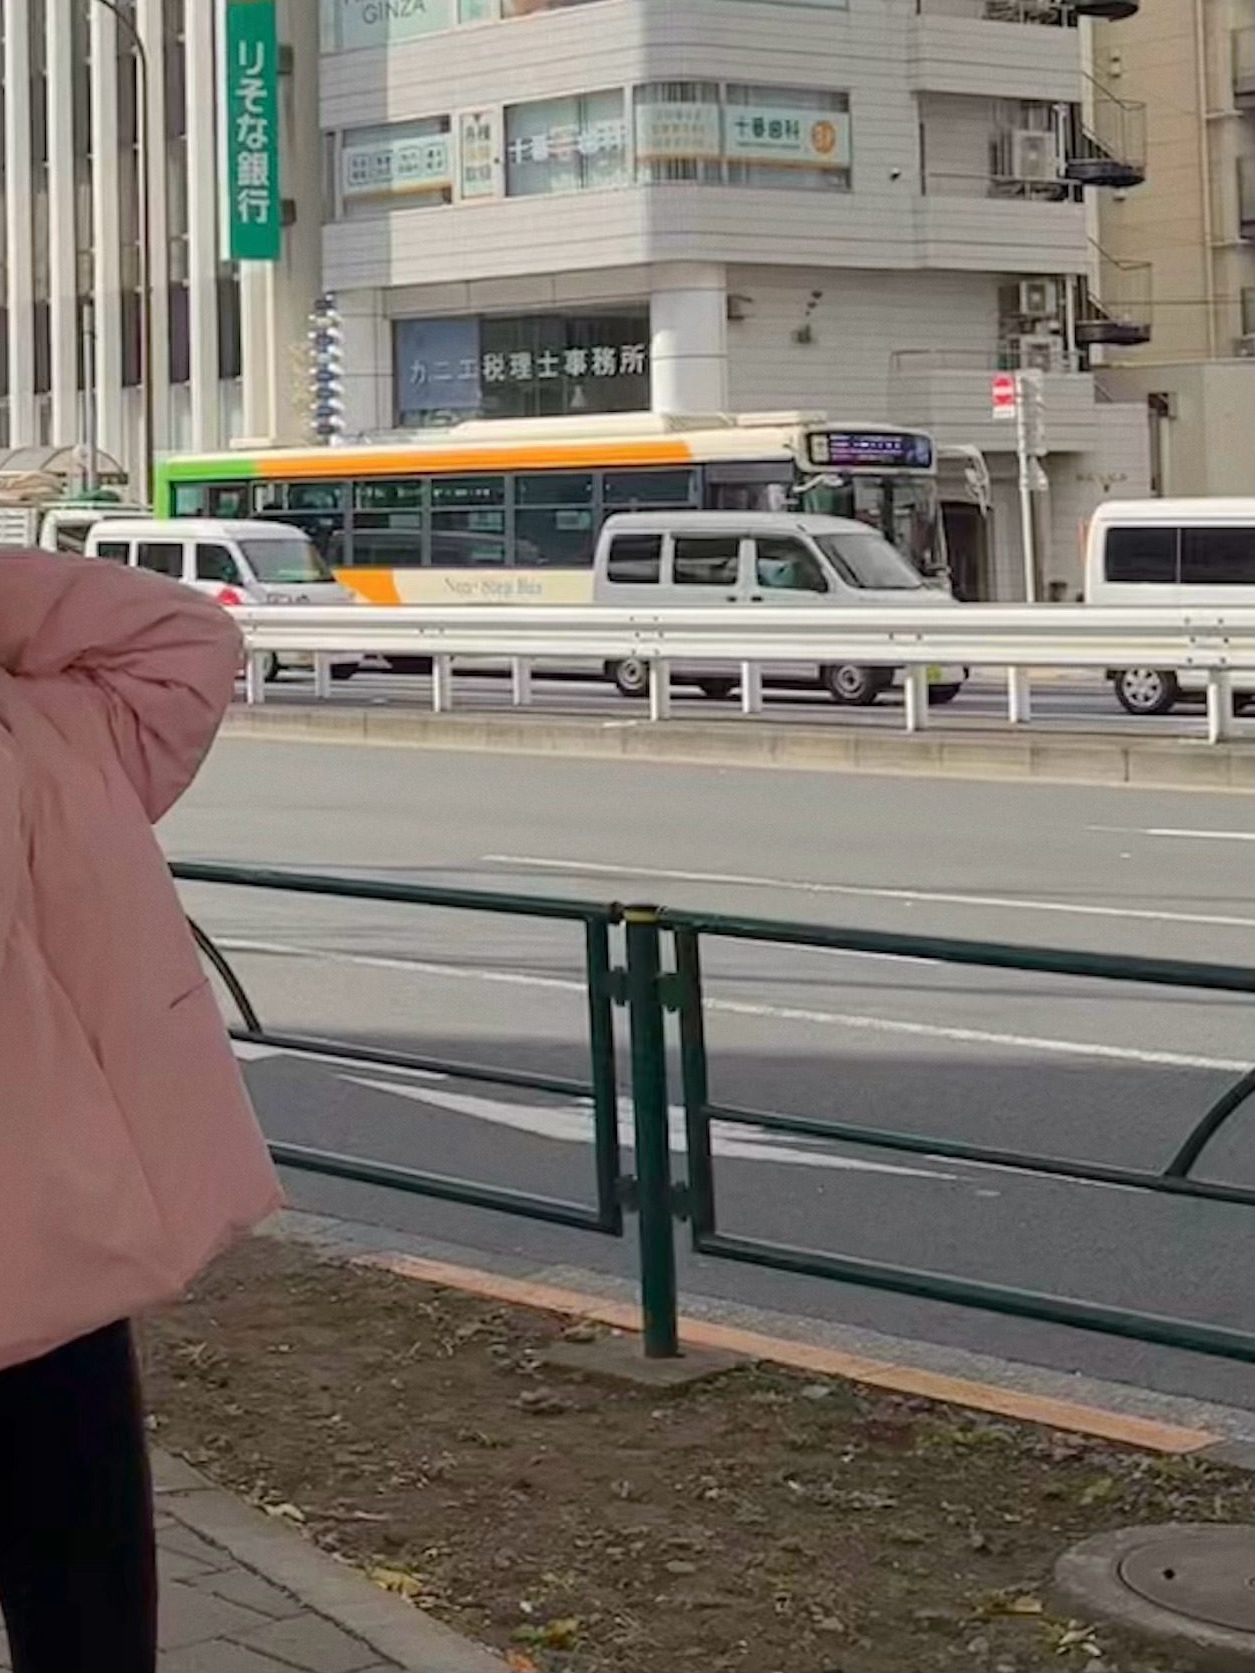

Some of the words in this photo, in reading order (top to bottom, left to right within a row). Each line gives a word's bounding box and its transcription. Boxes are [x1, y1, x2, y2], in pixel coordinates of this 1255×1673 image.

[234, 40, 271, 224] りそな銀行
